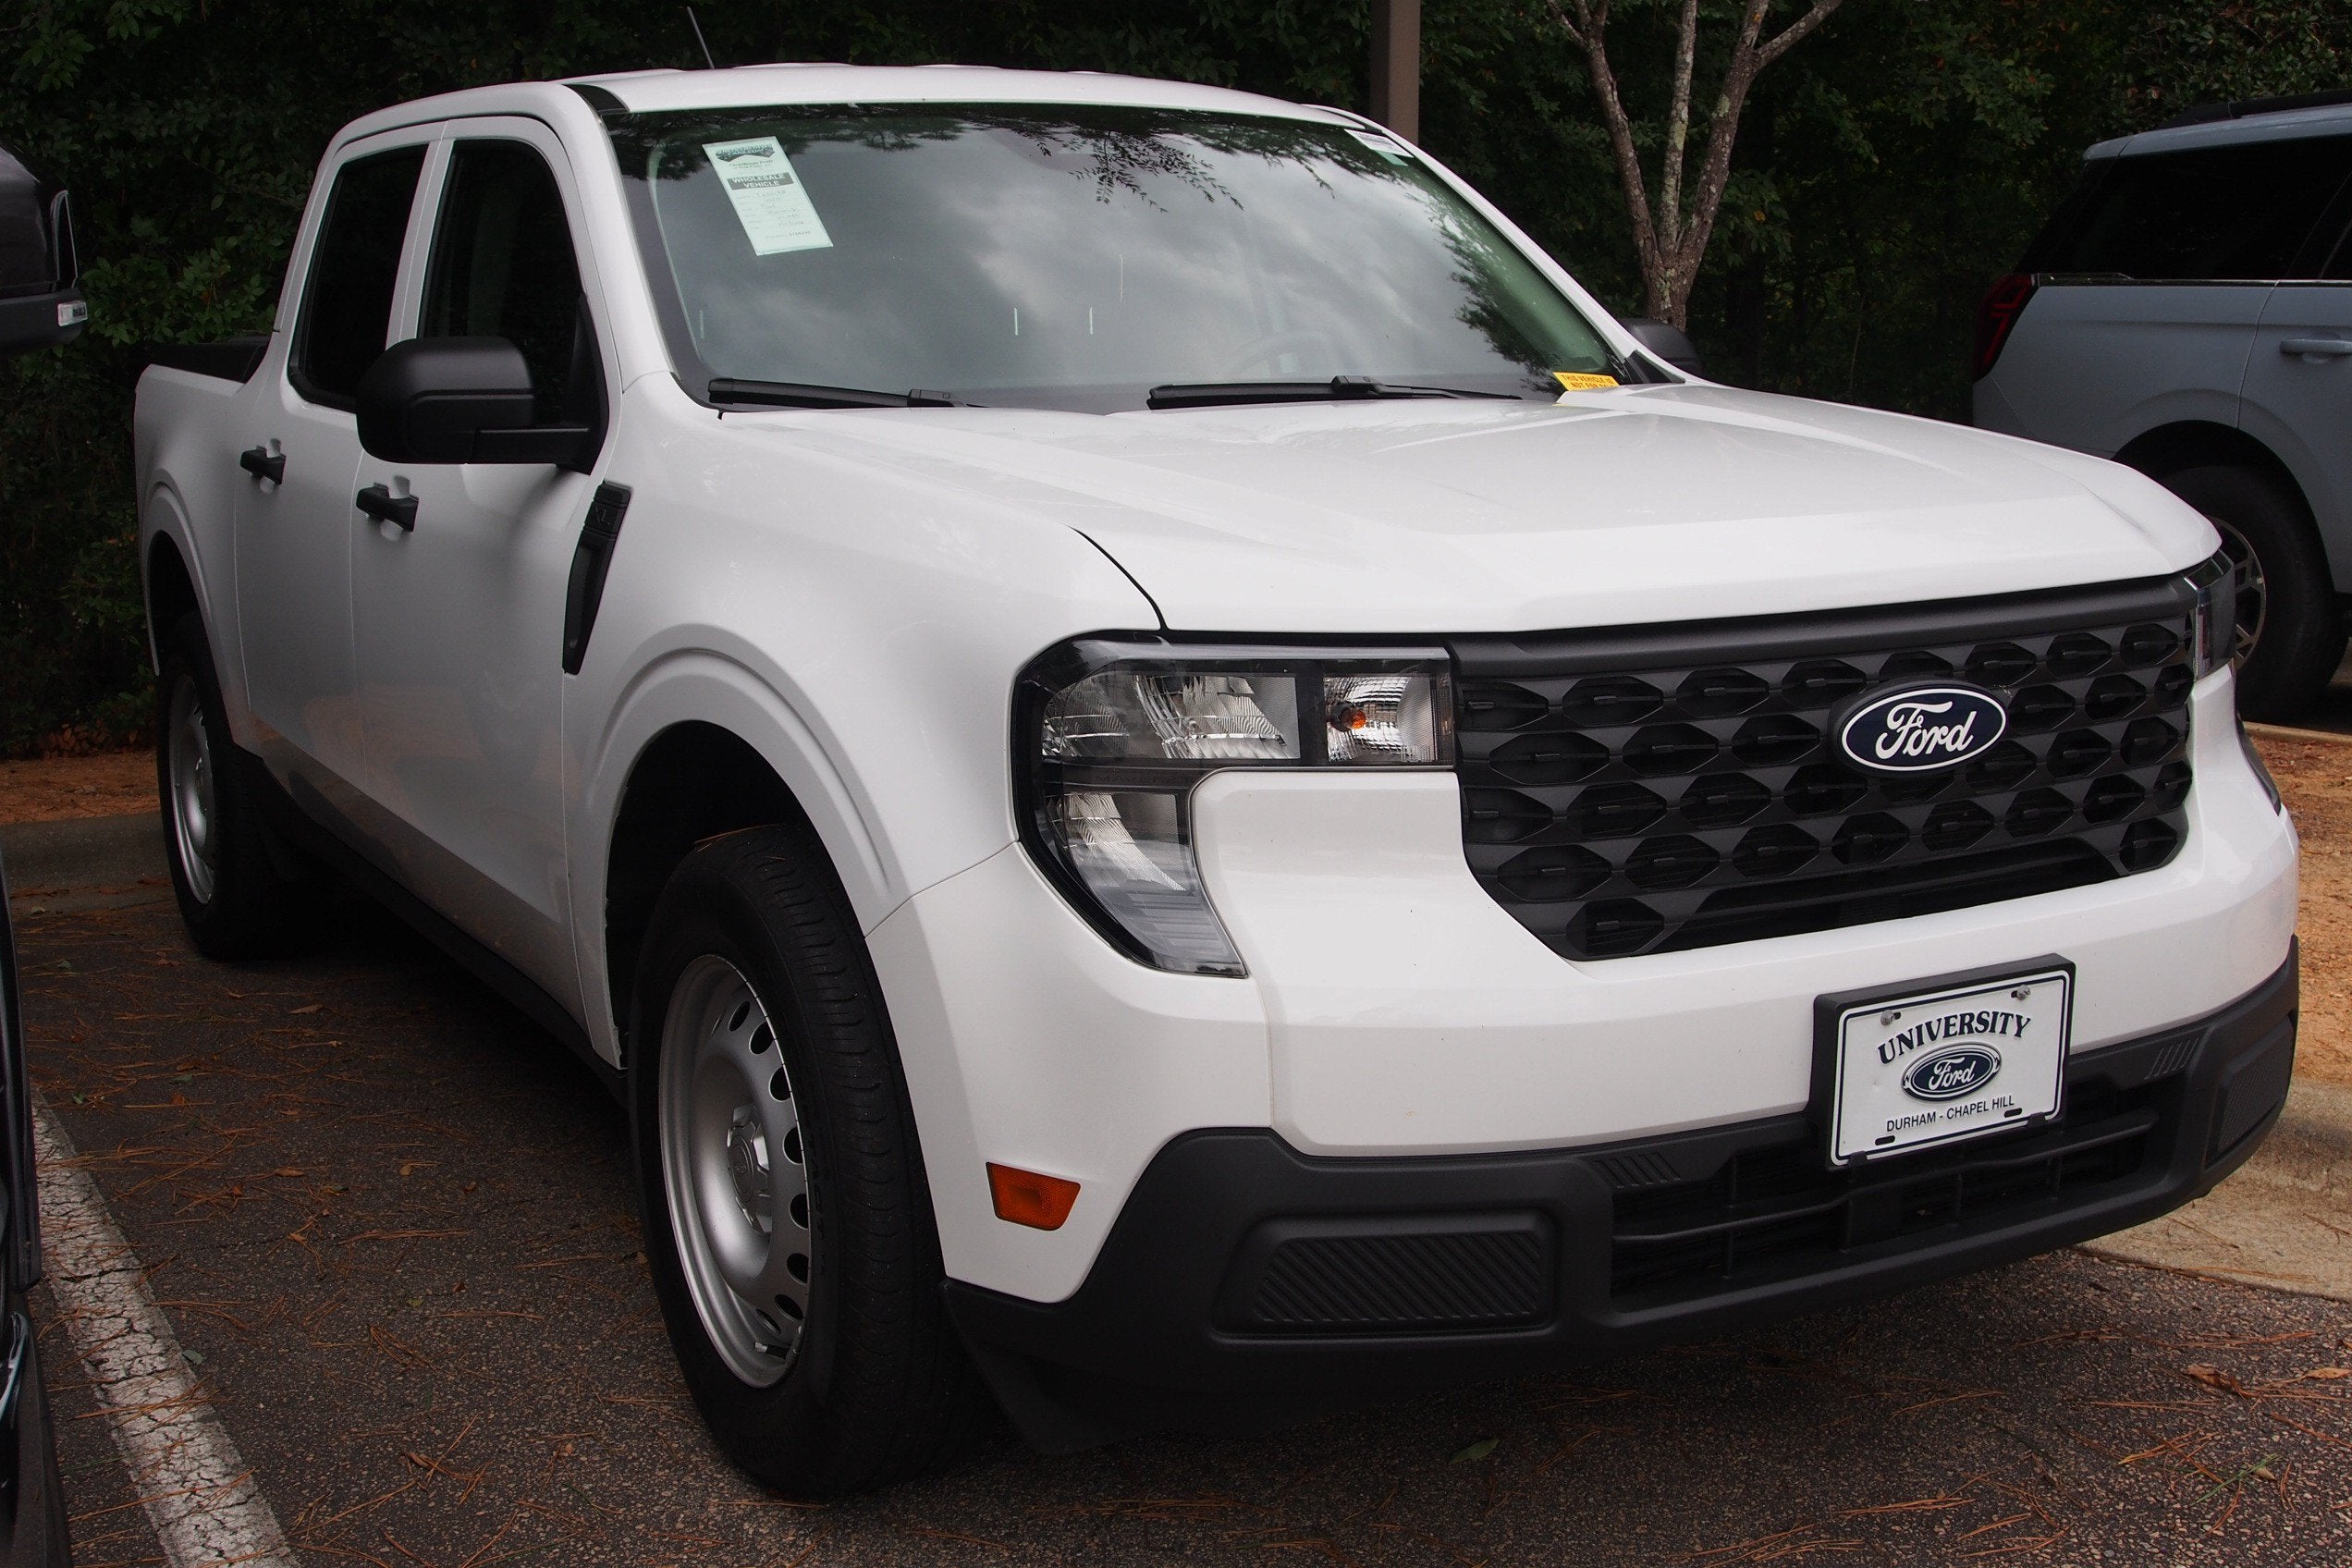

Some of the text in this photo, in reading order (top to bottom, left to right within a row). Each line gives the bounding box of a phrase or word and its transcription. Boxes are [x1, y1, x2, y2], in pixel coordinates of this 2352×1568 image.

[731, 173, 786, 183] WHOLESALE
[743, 179, 780, 188] VEHICLE
[1875, 701, 1977, 759] Ford
[1877, 1011, 2031, 1064] UNIVERSITY
[1928, 1056, 1977, 1091] Ford
[1886, 1113, 1936, 1132] DURHAM
[1946, 1100, 1989, 1120] CHAPEL
[1991, 1095, 2015, 1109] HILL
